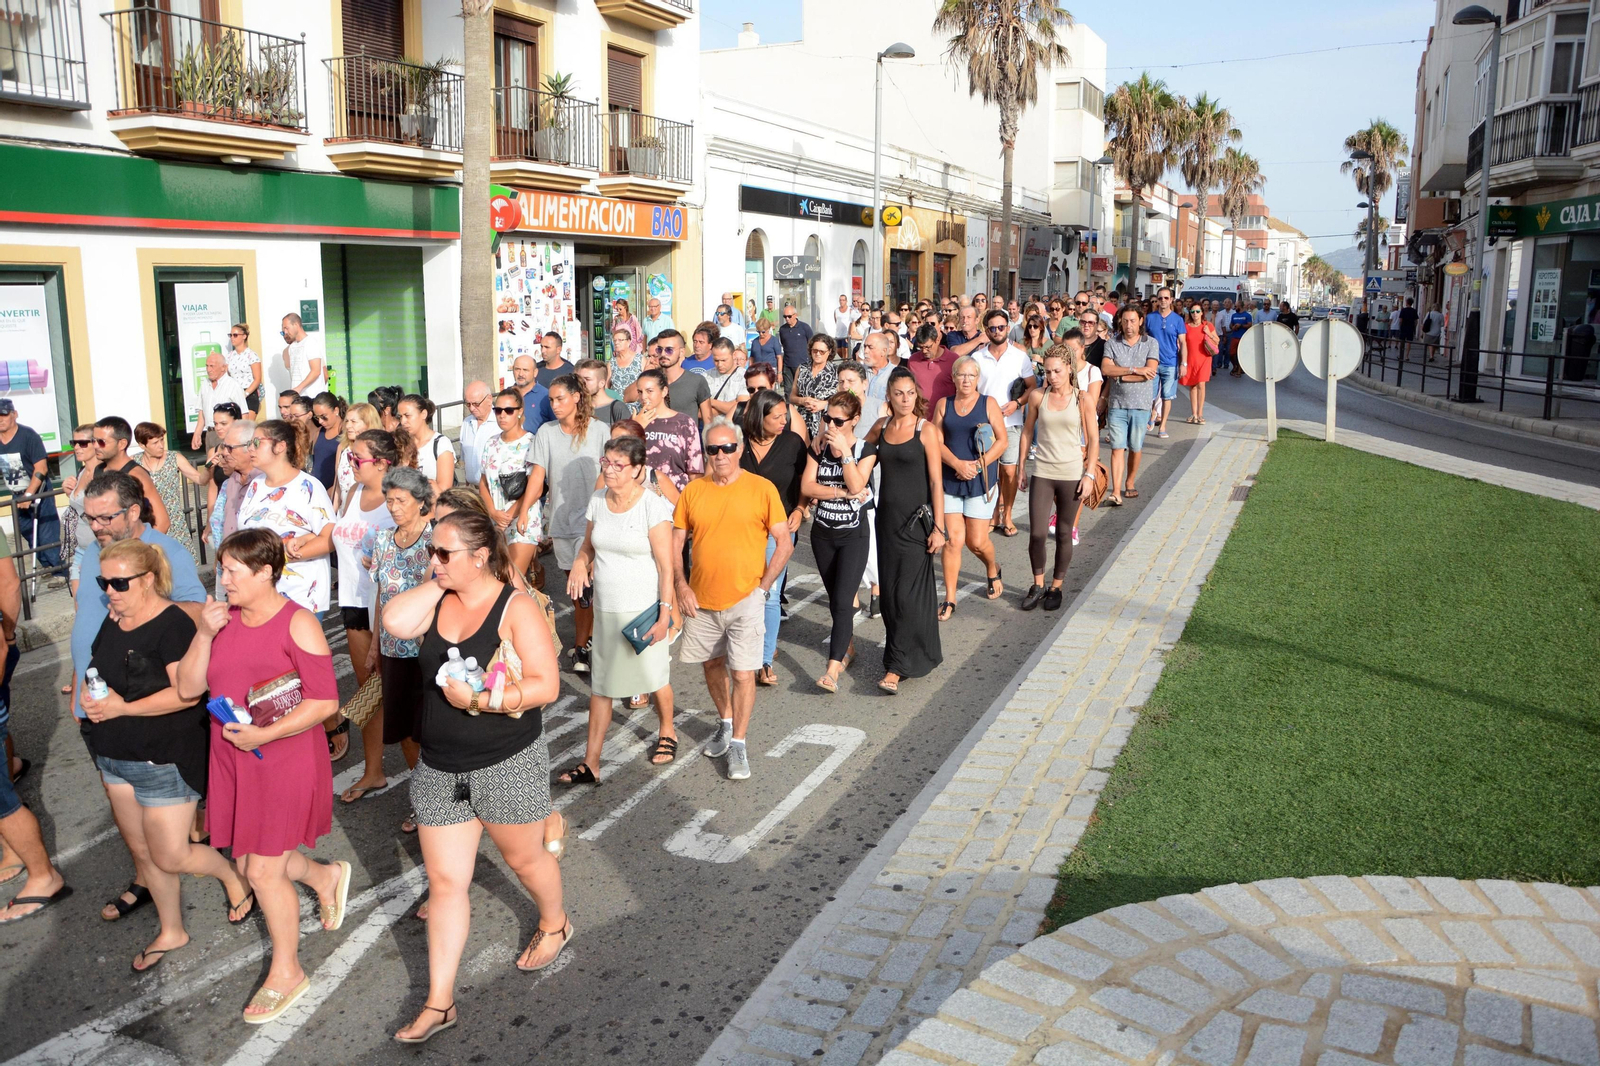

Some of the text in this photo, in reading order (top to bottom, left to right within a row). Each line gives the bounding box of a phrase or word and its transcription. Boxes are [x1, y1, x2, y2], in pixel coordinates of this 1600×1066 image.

[519, 192, 683, 238] ALIMENTACION BAO
[1560, 204, 1591, 225] CAJA
[182, 304, 208, 312] VIAJAR
[817, 507, 855, 521] WHISKEY
